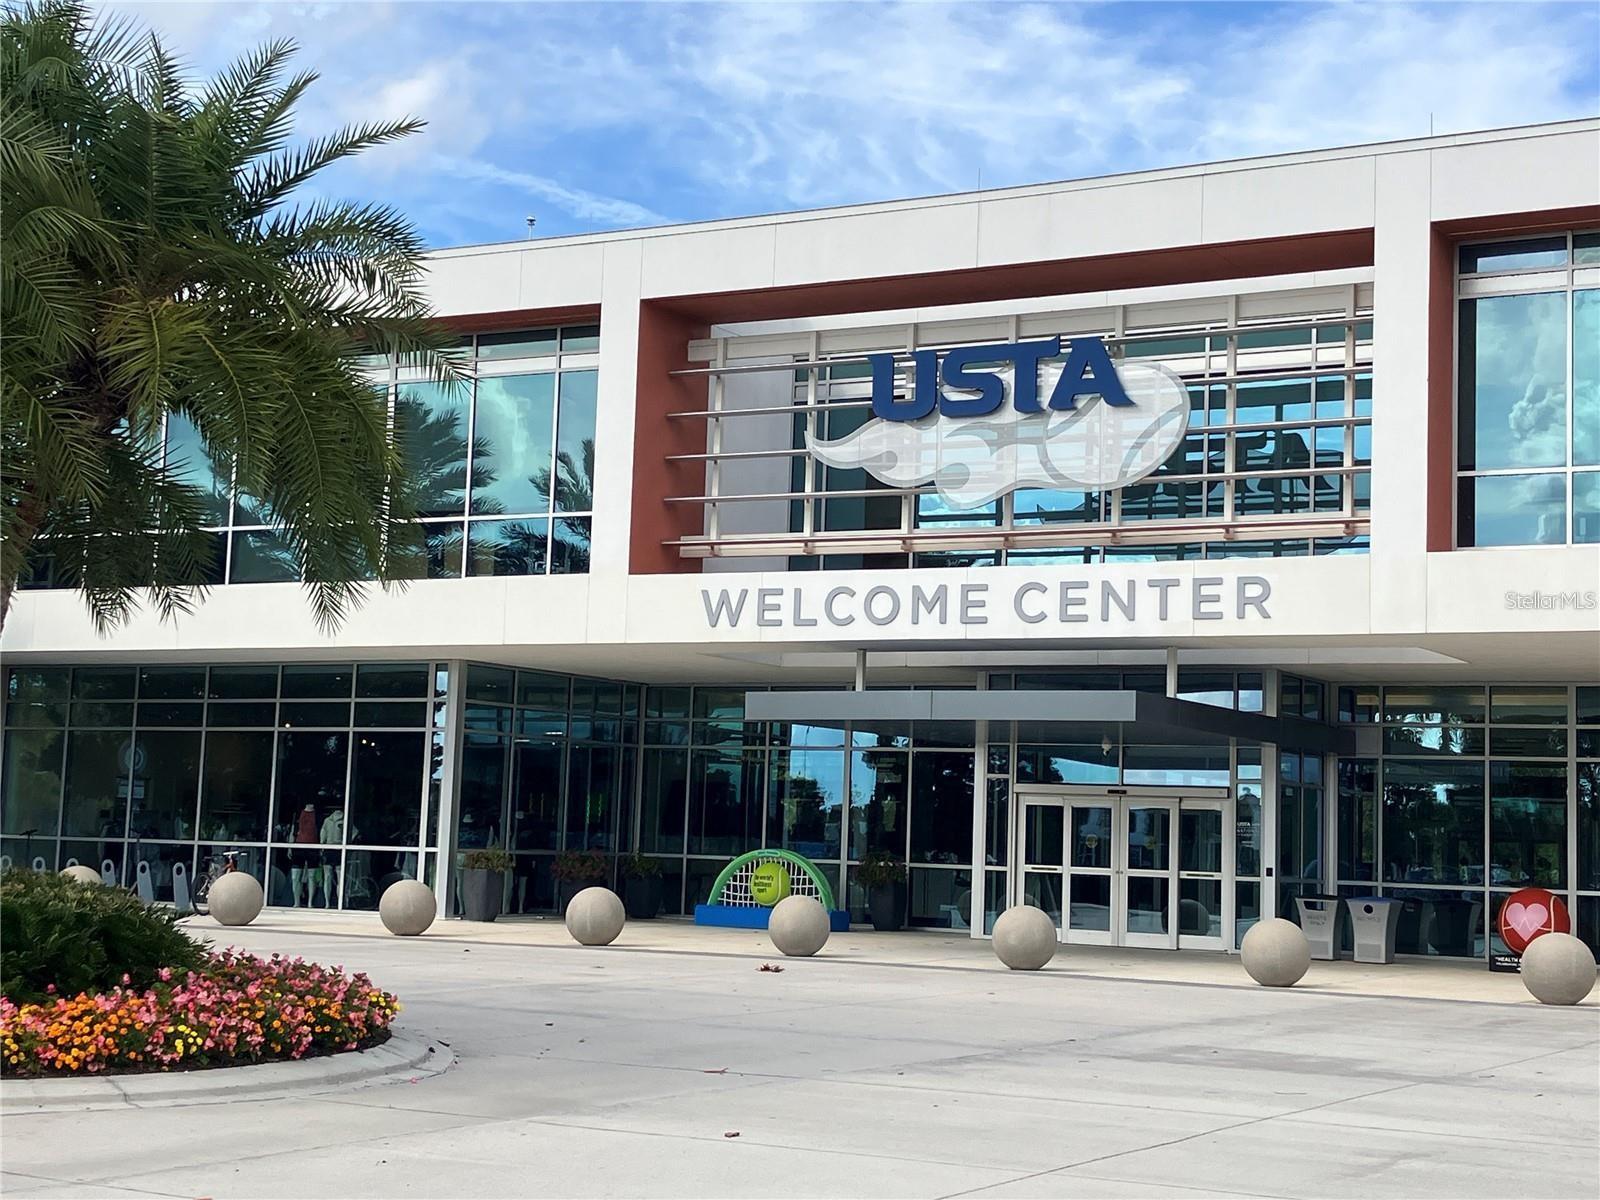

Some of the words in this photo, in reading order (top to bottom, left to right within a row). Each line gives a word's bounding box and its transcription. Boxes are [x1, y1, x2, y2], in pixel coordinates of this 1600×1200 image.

[867, 334, 1136, 421] USTA
[701, 584, 989, 628] WELCOME
[1013, 576, 1273, 624] CENTER
